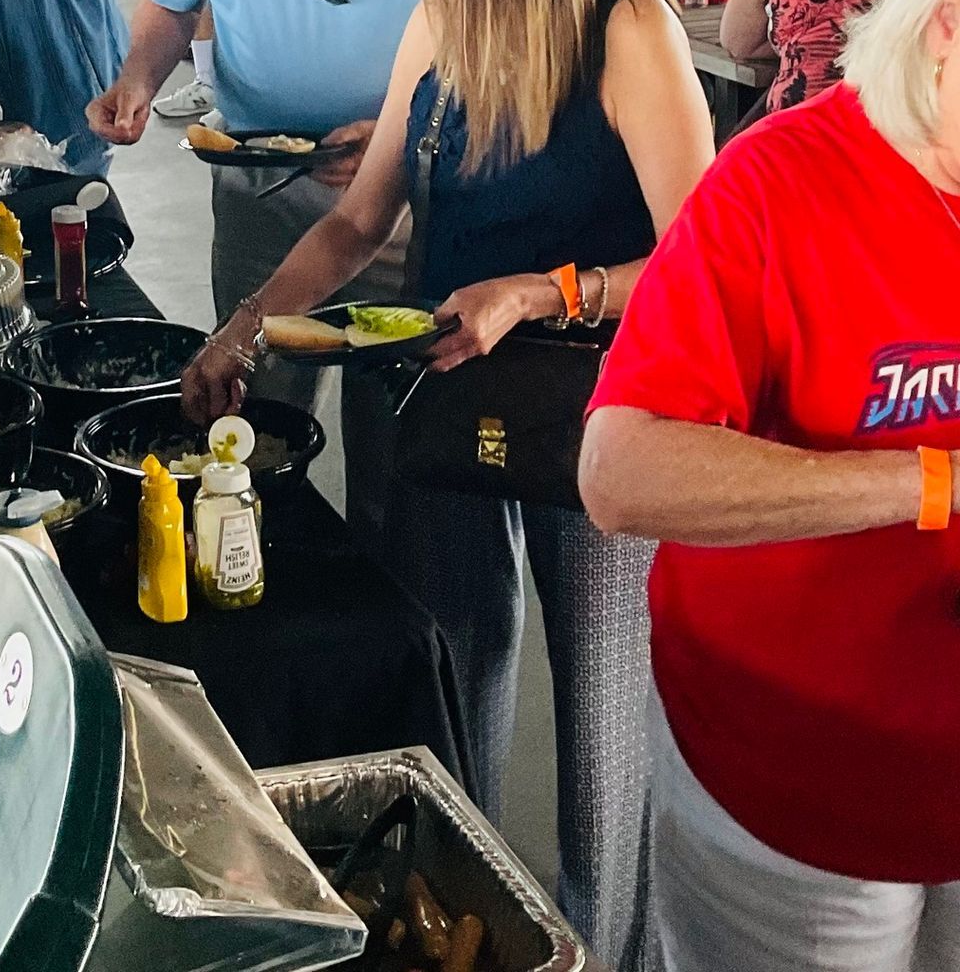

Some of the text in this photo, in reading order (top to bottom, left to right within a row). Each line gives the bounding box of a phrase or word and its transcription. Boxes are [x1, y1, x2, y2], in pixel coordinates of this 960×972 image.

[864, 362, 960, 428] JAC
[225, 572, 251, 584] HEINZ
[3, 659, 22, 706] 2
